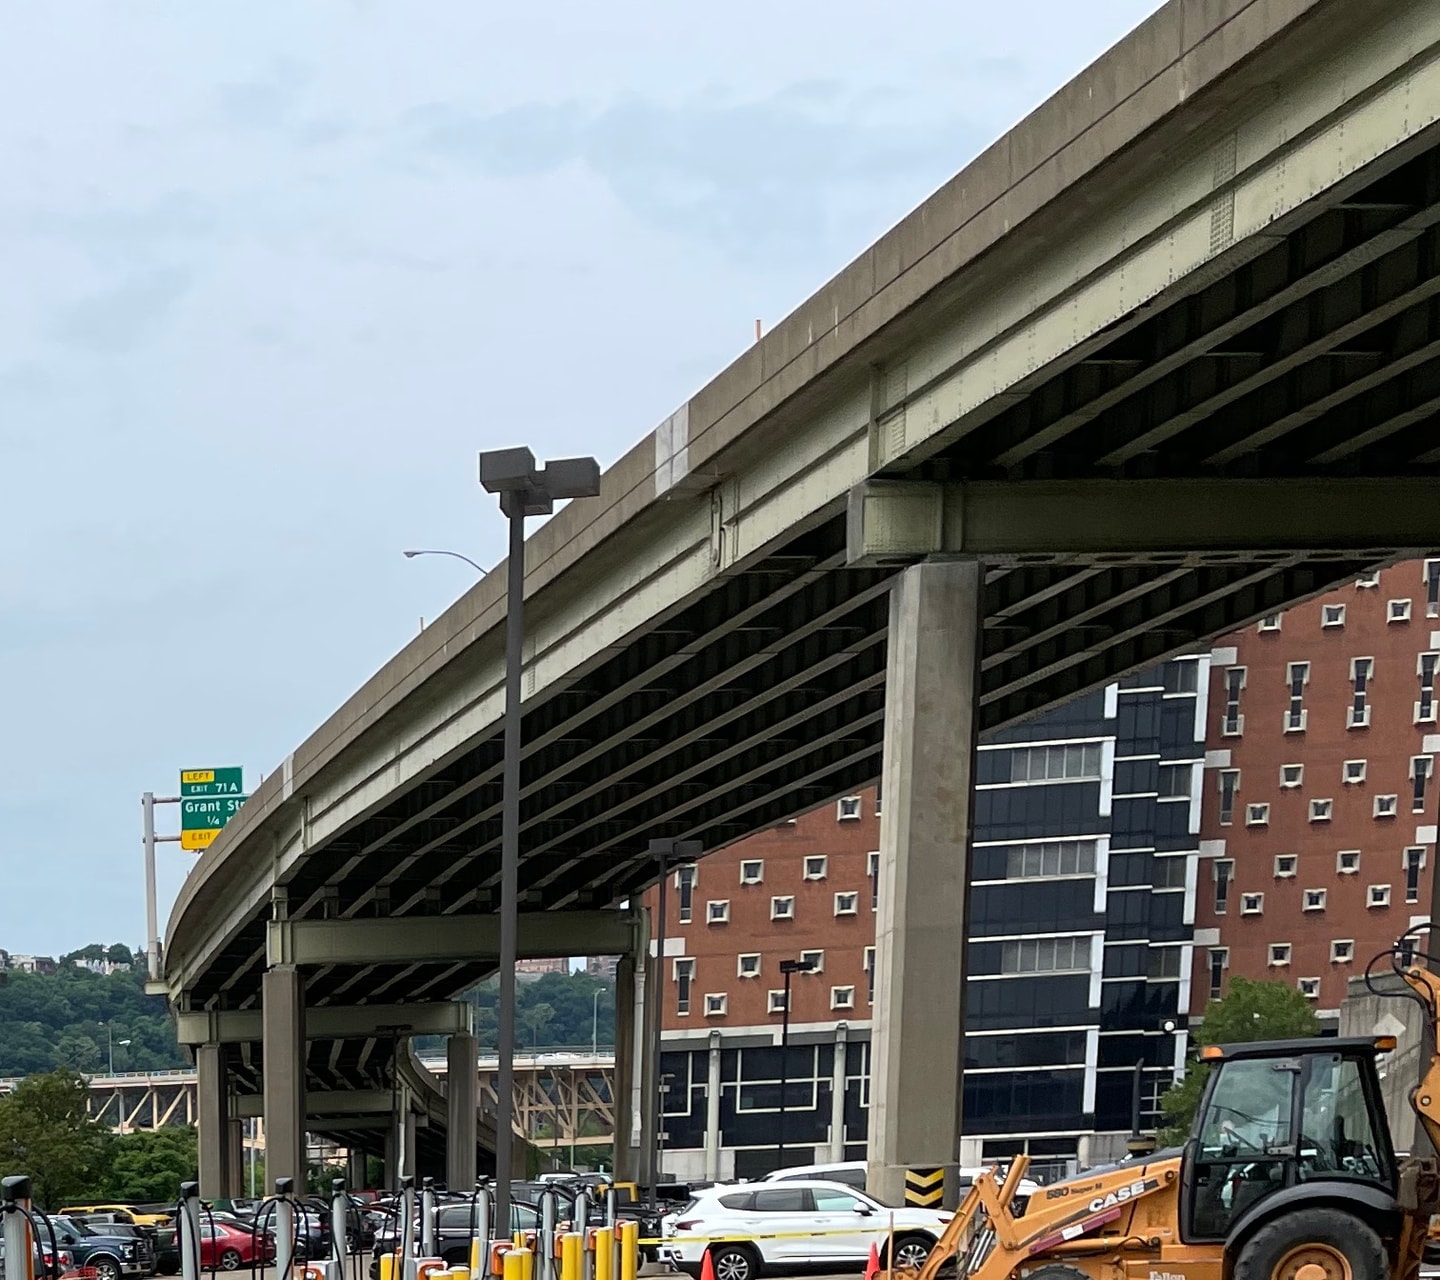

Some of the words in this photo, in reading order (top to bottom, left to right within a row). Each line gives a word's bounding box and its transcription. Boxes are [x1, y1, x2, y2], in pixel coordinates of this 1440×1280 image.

[187, 773, 209, 781] LEFT
[191, 785, 208, 793] EXIT
[185, 801, 221, 813] Grant
[192, 832, 211, 841] EXIT
[1088, 1180, 1145, 1212] CASE
